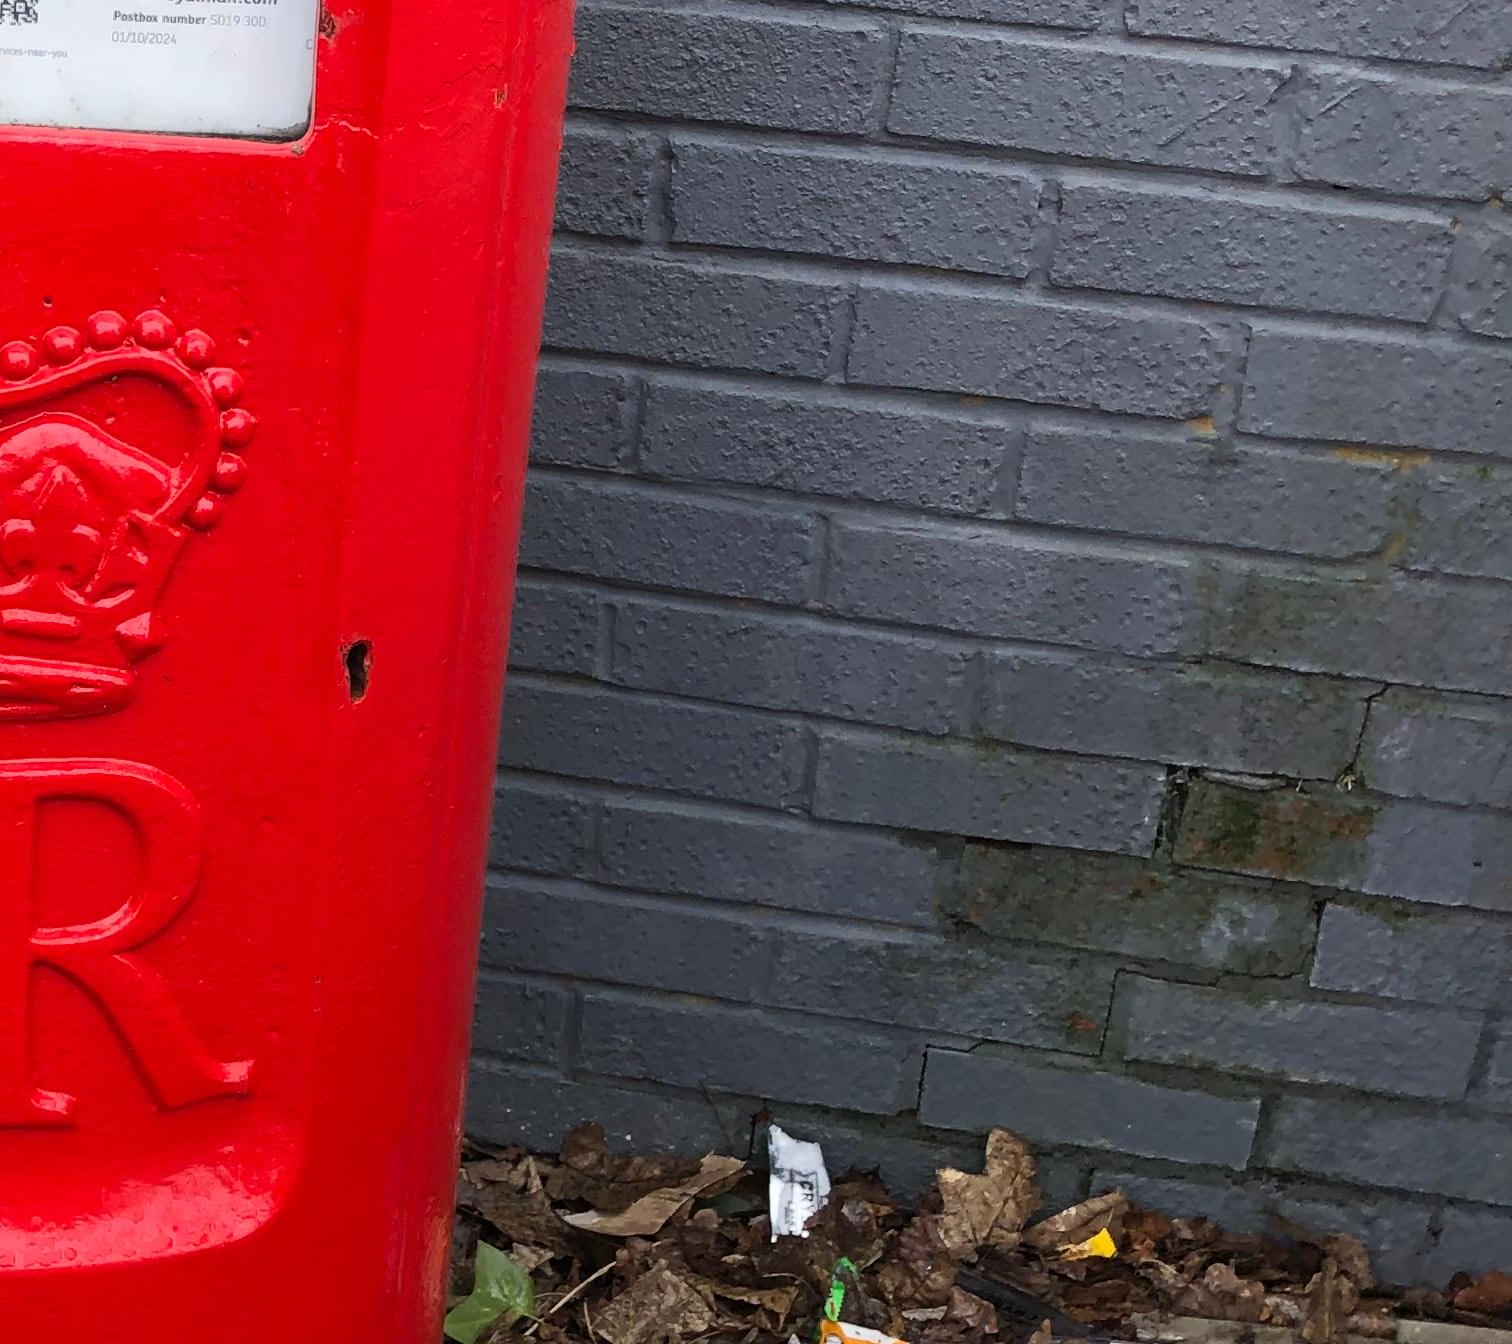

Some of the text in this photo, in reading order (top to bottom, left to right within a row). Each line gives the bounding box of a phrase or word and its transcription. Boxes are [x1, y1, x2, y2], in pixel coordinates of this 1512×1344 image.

[113, 10, 158, 23] Postbox
[162, 12, 207, 25] number
[111, 30, 177, 45] 01/10/2024
